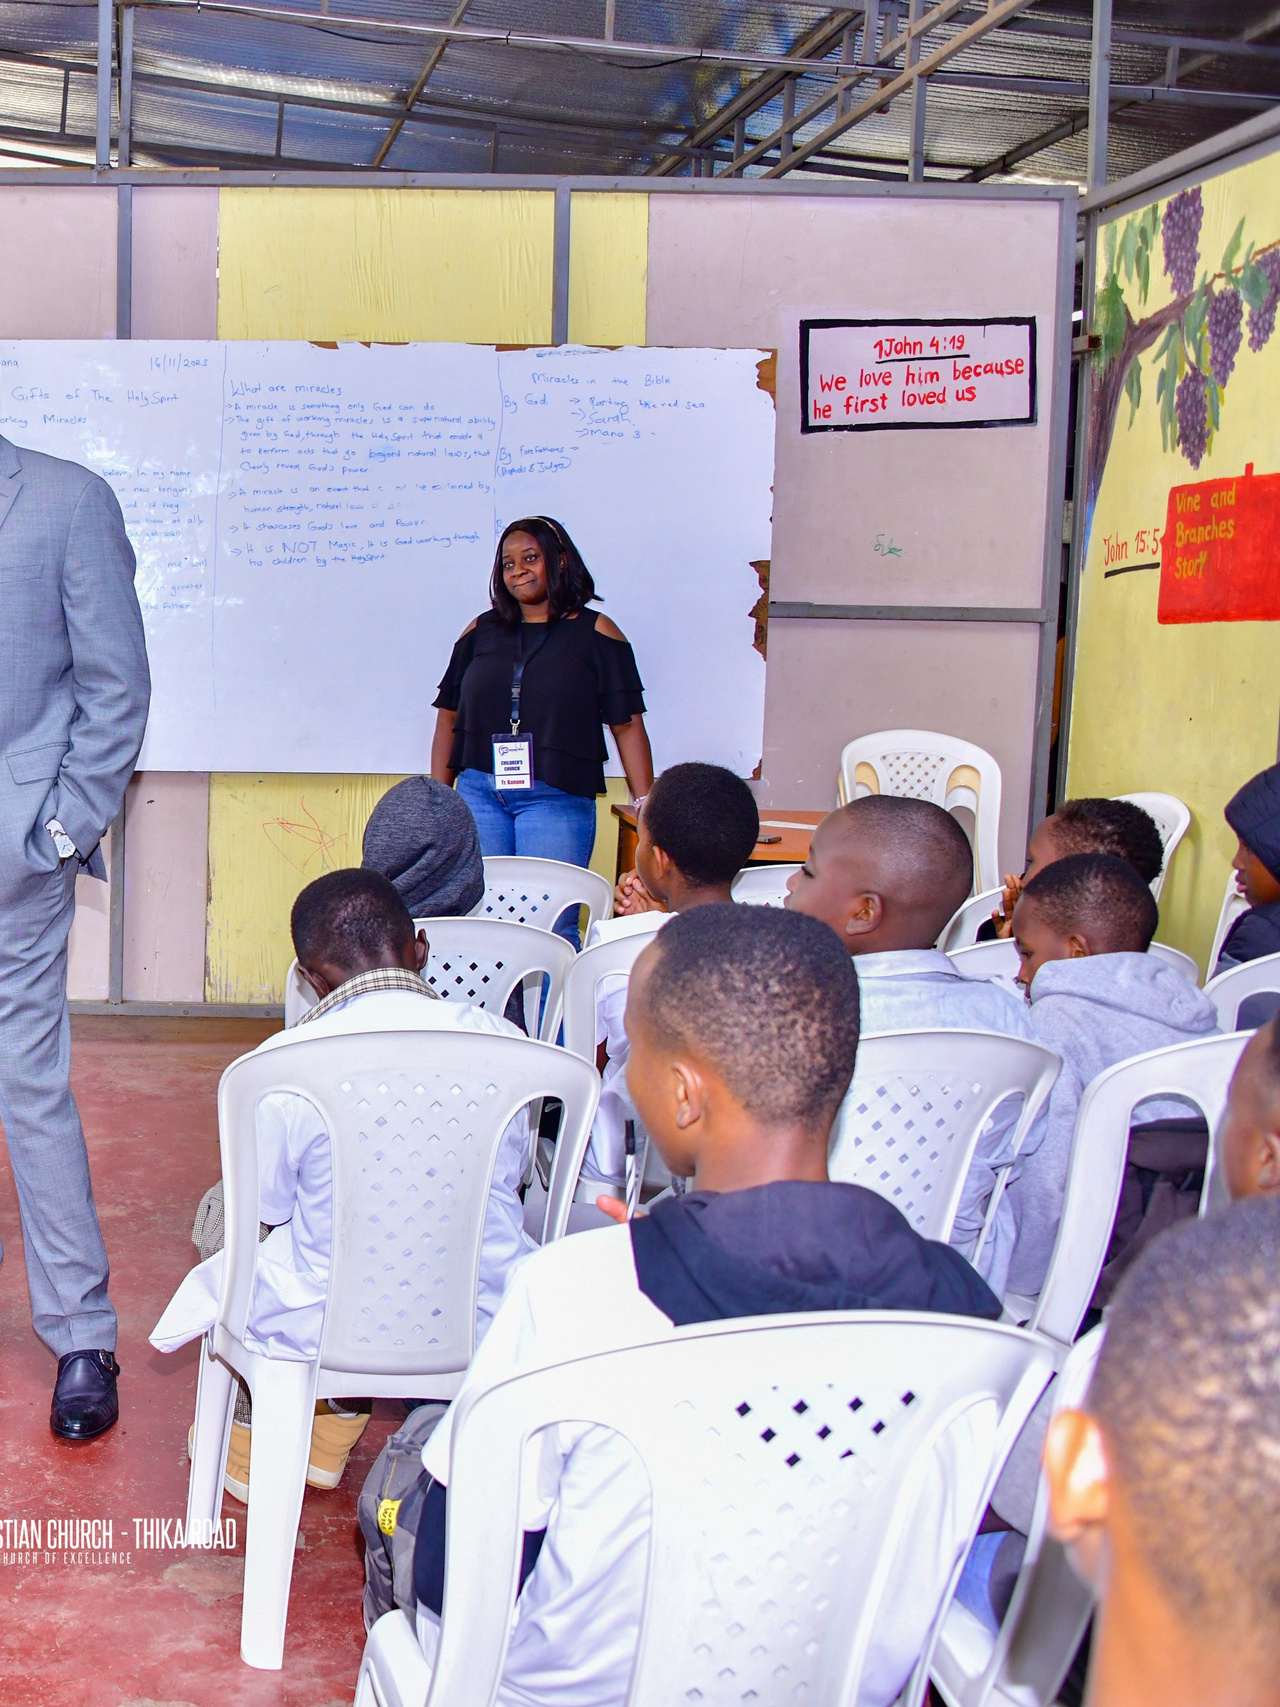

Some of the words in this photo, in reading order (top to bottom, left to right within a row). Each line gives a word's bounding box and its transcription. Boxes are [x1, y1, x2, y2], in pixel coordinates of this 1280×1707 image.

[930, 334, 966, 355] 4:19
[532, 372, 579, 384] Miracles
[820, 374, 847, 393] We
[859, 369, 893, 388] love
[905, 364, 940, 386] him
[953, 357, 1025, 381] because
[11, 386, 50, 401] Gifts
[65, 388, 80, 400] of
[91, 389, 113, 402] The
[295, 385, 342, 396] miracles
[301, 403, 340, 414] something
[348, 402, 365, 413] only
[373, 402, 392, 411] God
[423, 402, 435, 411] do
[813, 399, 832, 420] he
[844, 393, 888, 415] first
[901, 387, 947, 408] loved
[955, 385, 977, 402] us
[235, 415, 250, 423] The
[256, 415, 274, 430] gift
[281, 414, 291, 423] of
[296, 415, 331, 428] working
[334, 416, 374, 425] miracles
[468, 416, 496, 431] ability
[240, 431, 261, 441] given
[266, 430, 278, 441] by
[422, 431, 442, 439] that
[241, 447, 252, 455] to
[322, 446, 338, 455] that
[343, 450, 356, 460] go
[408, 448, 437, 457] natural
[1176, 490, 1201, 515] Vine
[1210, 481, 1237, 508] and
[369, 520, 385, 528] and
[1175, 515, 1235, 548] Branches
[282, 541, 318, 554] NOT
[395, 537, 412, 545] God
[1103, 531, 1129, 567] John
[1135, 528, 1160, 556] 15:5
[272, 556, 307, 566] children
[1175, 551, 1208, 580] Story
